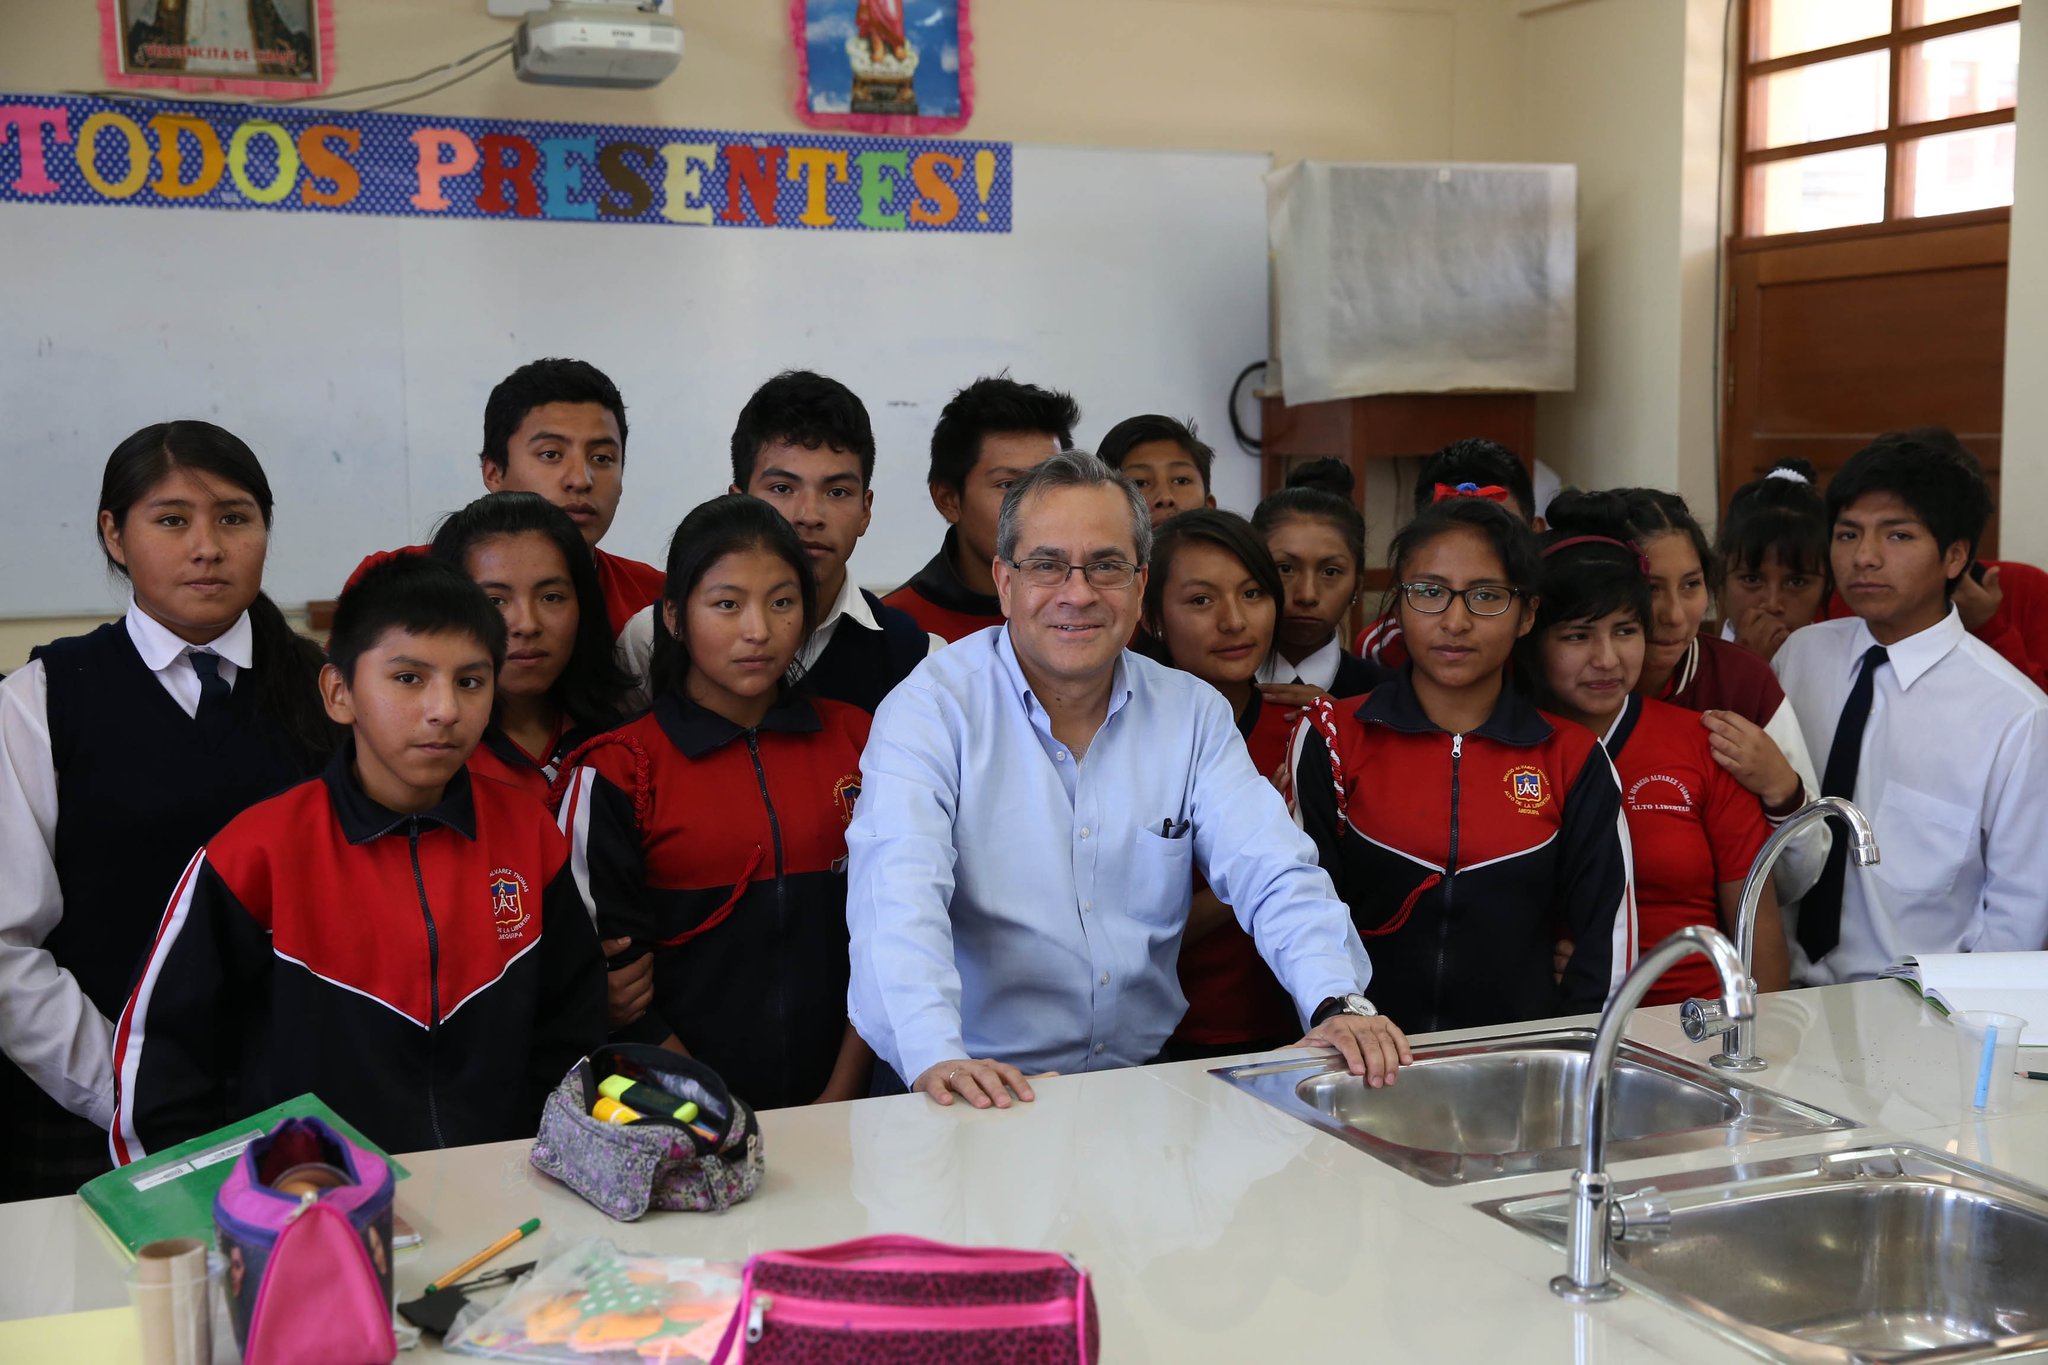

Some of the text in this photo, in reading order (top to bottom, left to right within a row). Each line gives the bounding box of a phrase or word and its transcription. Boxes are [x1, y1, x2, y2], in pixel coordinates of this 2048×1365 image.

[0, 105, 997, 231] TODOS PRESENTES!
[1629, 776, 1650, 794] IGNACIO
[1650, 774, 1678, 786] ALVAREZ
[1677, 782, 1693, 805] THOMAS
[1654, 804, 1690, 812] LIBERTAD
[489, 868, 529, 893] ALVAREZ THOMAS
